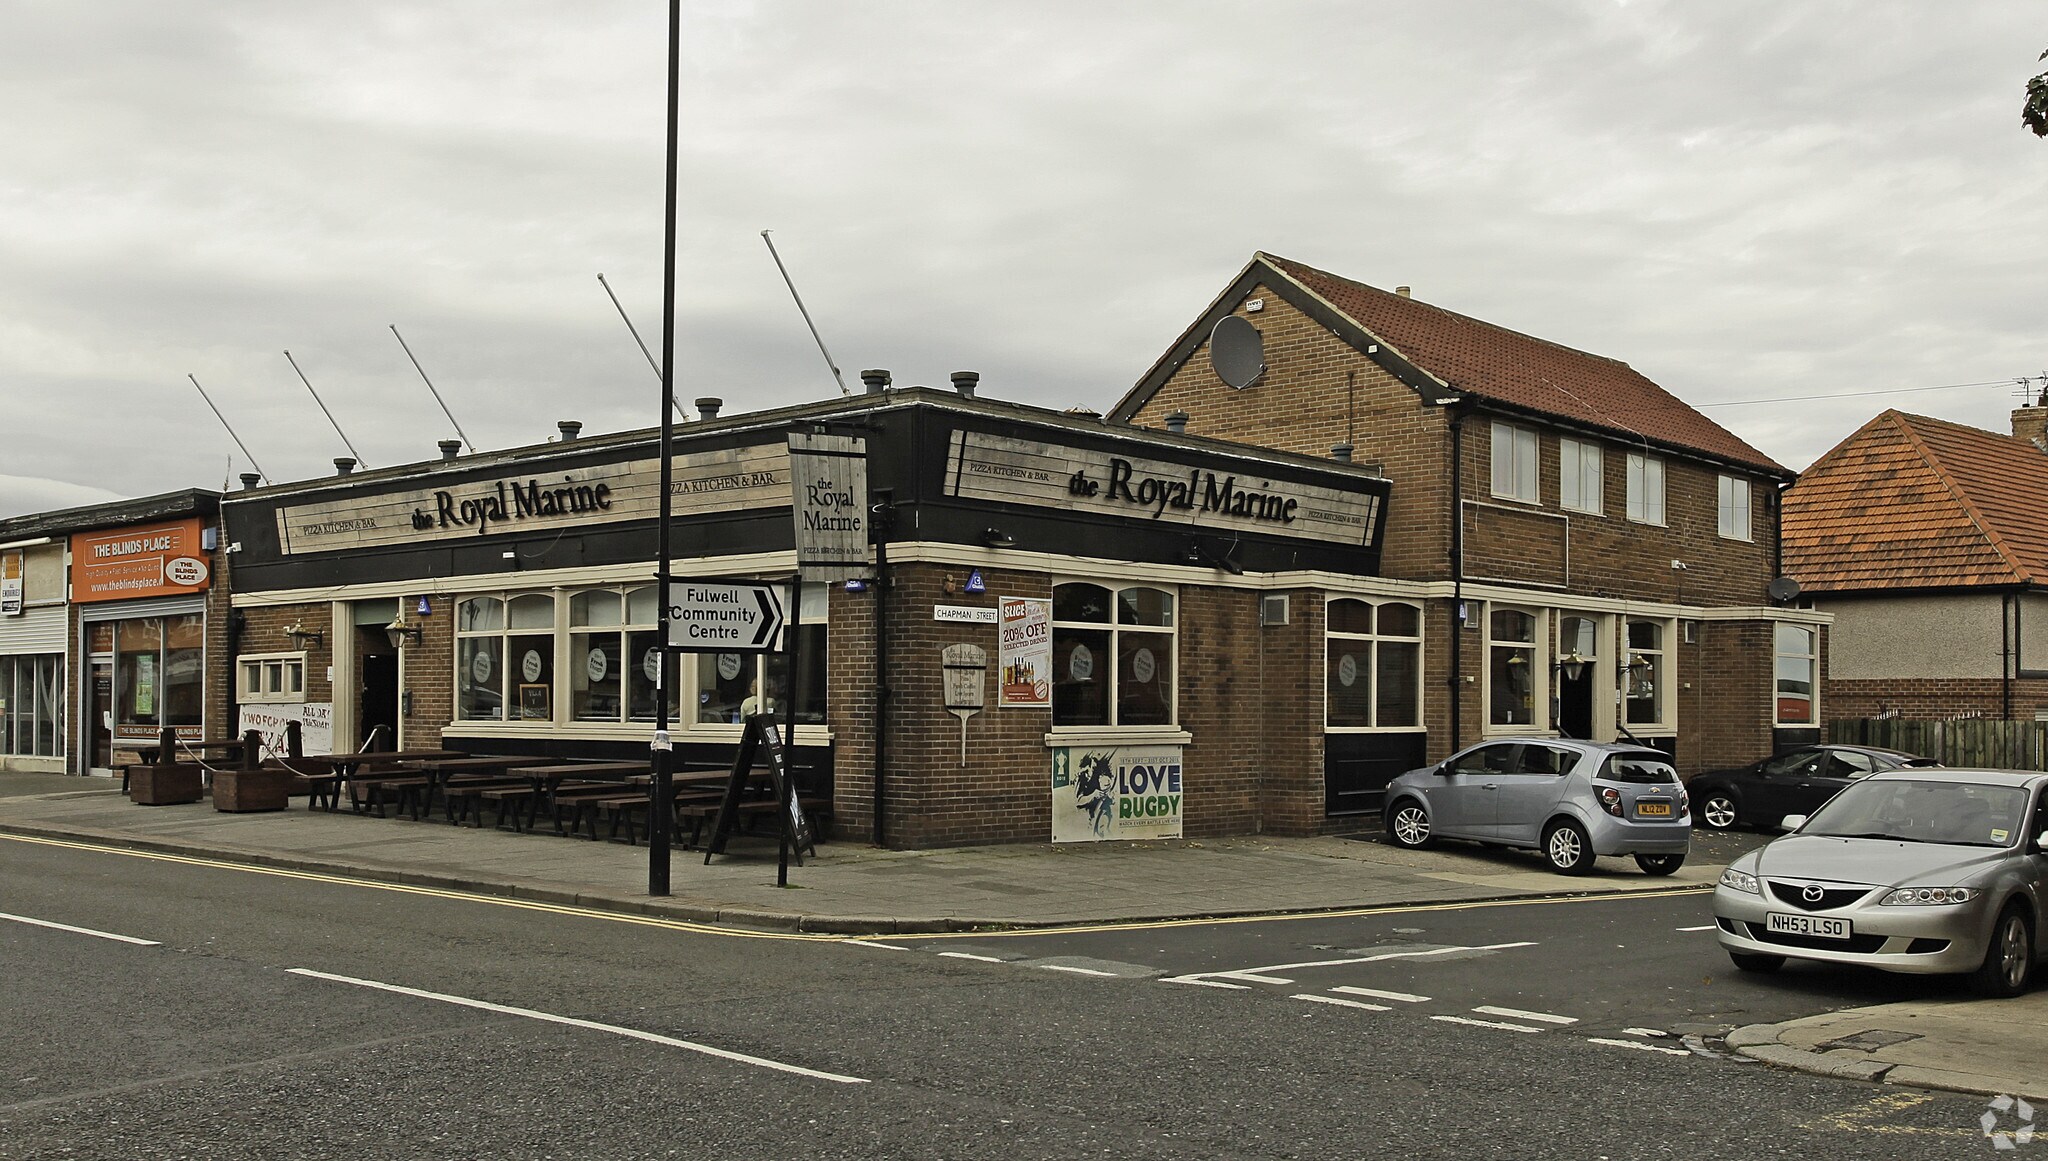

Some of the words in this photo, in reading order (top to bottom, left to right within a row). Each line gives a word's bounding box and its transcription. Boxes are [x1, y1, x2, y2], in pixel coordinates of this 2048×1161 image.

[970, 463, 992, 473] PIZZA
[993, 466, 1026, 478] KITCHEN
[1028, 471, 1034, 479] &
[1034, 472, 1050, 481] BAR
[670, 482, 690, 494] ZZA
[692, 476, 740, 492] KITCHEN
[742, 476, 750, 486] &
[751, 472, 776, 486] BAR
[818, 477, 832, 490] the
[1069, 470, 1099, 498] the
[1104, 458, 1200, 519] Royal
[1200, 473, 1298, 524] Marine
[412, 508, 434, 530] the
[434, 480, 510, 534] Royal
[510, 475, 612, 518] Marine
[806, 485, 854, 512] Royal
[804, 510, 861, 531] Marine
[1308, 510, 1323, 518] PIZZA
[304, 525, 322, 536] PIZZA
[323, 521, 354, 534] KITCHEN
[362, 518, 377, 528] BAR
[94, 544, 110, 558] THE
[112, 540, 142, 556] BLINDS
[144, 536, 170, 552] PLACE
[688, 588, 738, 603] Fulwell
[671, 606, 756, 624] Community
[936, 610, 972, 618] CHAPMAN
[976, 612, 996, 620] STREET
[1004, 604, 1026, 618] SLICE
[689, 624, 738, 638] Centre
[1004, 626, 1024, 642] 20%
[1026, 622, 1047, 638] OFF
[1004, 640, 1030, 650] SELECTED
[1030, 637, 1048, 646] DRINKS
[1119, 765, 1180, 794] LOVE
[1119, 795, 1180, 818] RUGBY
[1772, 916, 1808, 932] NH53
[1812, 920, 1842, 935] LSO
